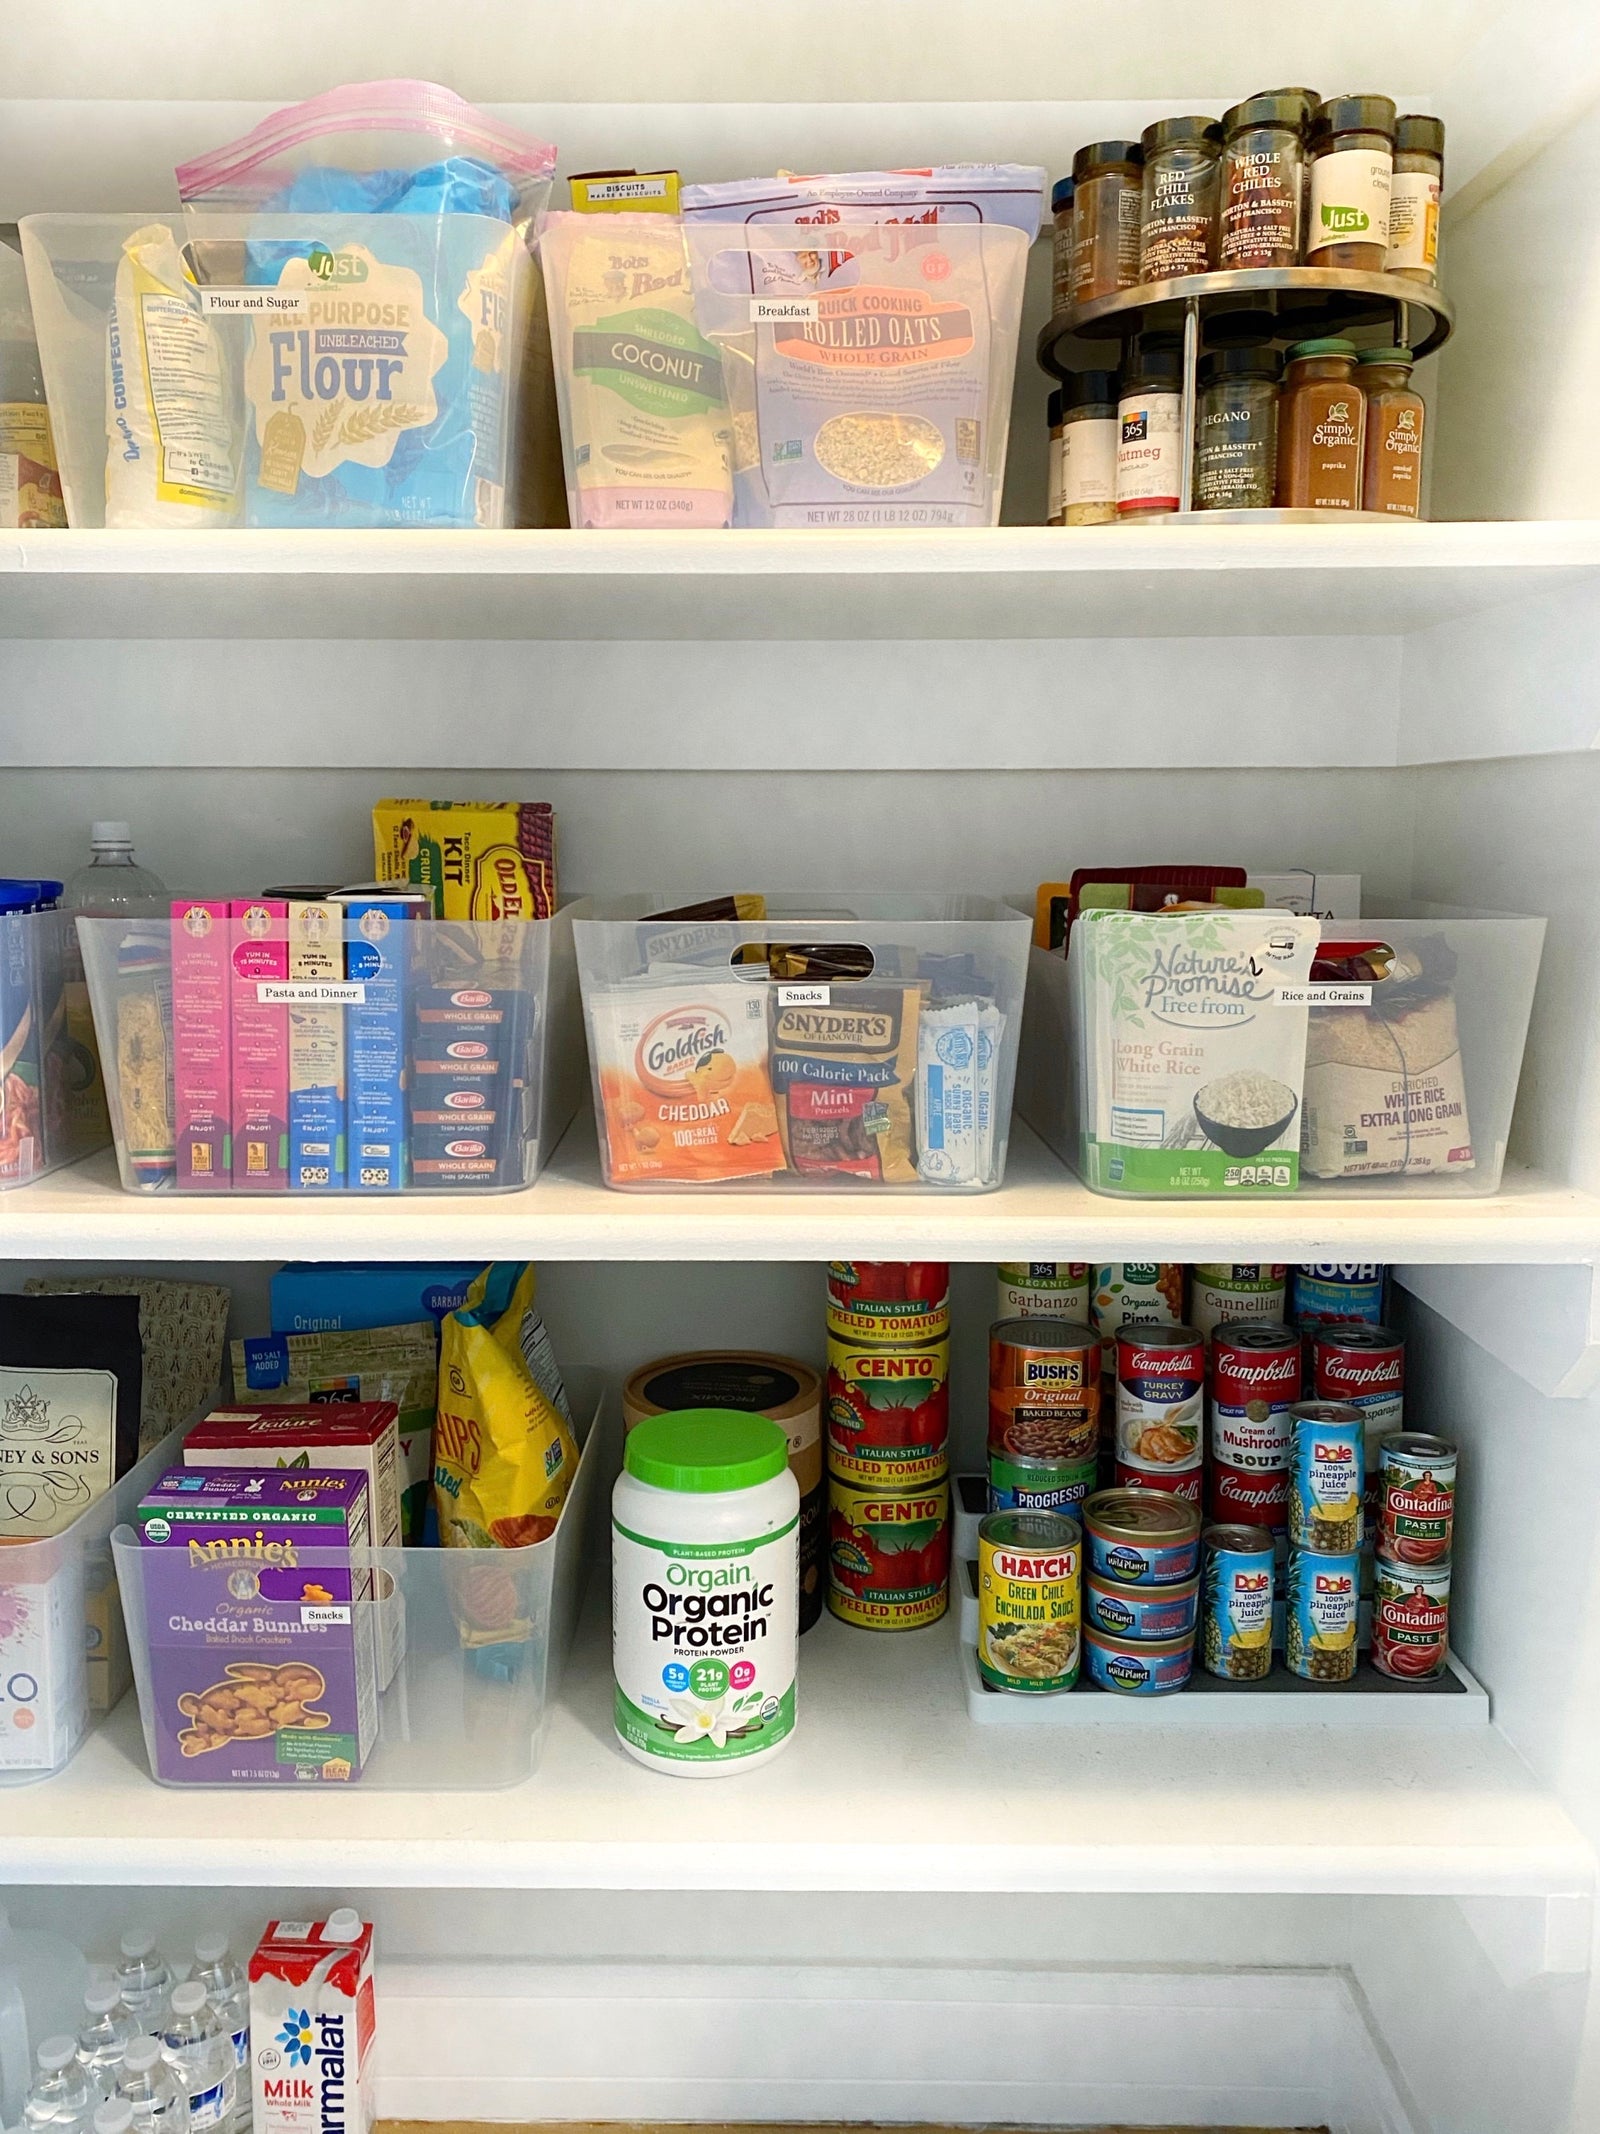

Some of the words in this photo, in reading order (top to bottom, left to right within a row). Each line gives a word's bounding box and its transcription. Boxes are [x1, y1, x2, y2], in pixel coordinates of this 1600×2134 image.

[1235, 153, 1281, 170] WHOLE
[1159, 170, 1185, 185] RED
[1243, 166, 1270, 179] RED
[606, 184, 645, 192] BISCUITS
[1155, 182, 1189, 197] CHILI
[1232, 177, 1282, 194] CHILIES
[1150, 194, 1195, 211] FLAKES
[1325, 209, 1364, 229] Just
[630, 269, 682, 300] Red
[210, 297, 241, 308] Flour
[244, 298, 263, 308] and
[266, 297, 299, 310] Sugar
[757, 305, 811, 316] Breakfast
[818, 295, 857, 315] QUICK
[862, 296, 923, 312] COOKING
[635, 324, 686, 345] SHREDDED
[803, 317, 881, 348] ROLLED
[889, 316, 942, 345] OATS
[319, 333, 399, 349] UNBLEACHED
[611, 342, 704, 382] COCONUT
[818, 350, 876, 364] WHOLE
[879, 348, 929, 363] GRAIN
[270, 330, 404, 402] Flour
[619, 374, 689, 402] UNSWEETENED
[1124, 421, 1143, 439] 365
[1317, 423, 1354, 439] Simply
[1388, 431, 1419, 444] Simply
[1313, 434, 1357, 448] Organic
[1386, 440, 1419, 454] Organic
[1322, 462, 1346, 470] paprika
[807, 511, 825, 522] NET
[827, 511, 840, 522] WT
[843, 511, 856, 522] 28
[857, 511, 870, 522] OZ
[884, 511, 896, 522] LB
[899, 511, 910, 522] 12
[912, 511, 928, 523] OZ)
[930, 511, 954, 524] 794g
[443, 837, 463, 886] KIT
[1152, 943, 1263, 977] Nature's
[265, 988, 295, 998] Pasta
[298, 988, 318, 998] and
[321, 988, 358, 998] Dinner
[785, 991, 822, 1000] Snacks
[1140, 975, 1275, 1008] Promise
[1281, 990, 1304, 1001] Rice
[1305, 990, 1326, 1001] and
[1329, 990, 1365, 1001] Grains
[1160, 996, 1197, 1013] Free
[1200, 996, 1245, 1015] from
[444, 1013, 472, 1021] WHOLE
[474, 1013, 499, 1021] GRAIN
[782, 1012, 886, 1037] SNYDER'S
[648, 1025, 727, 1072] Goldfish
[1116, 1038, 1153, 1059] Long
[1158, 1041, 1205, 1057] Grain
[440, 1064, 468, 1072] WHOLE
[470, 1064, 495, 1072] GRAIN
[778, 1060, 798, 1073] 100
[803, 1064, 853, 1081] Calorie
[857, 1068, 890, 1082] Pack
[1116, 1057, 1161, 1074] White
[1166, 1059, 1201, 1075] Rice
[1391, 1076, 1439, 1092] ENRICHED
[810, 1089, 854, 1106] Mini
[1384, 1089, 1422, 1108] WHITE
[1424, 1088, 1446, 1102] RICE
[658, 1098, 731, 1121] CHEDDAR
[1360, 1111, 1400, 1128] EXTRA
[1403, 1108, 1434, 1124] LONG
[1435, 1102, 1462, 1119] GRAIN
[438, 1114, 465, 1122] WHOLE
[467, 1114, 492, 1122] GRAIN
[438, 1162, 466, 1170] WHOLE
[467, 1162, 493, 1170] GRAIN
[1032, 1263, 1053, 1275] 365
[1235, 1267, 1257, 1279] 365
[1017, 1278, 1070, 1288] ORGANIC
[1218, 1280, 1272, 1290] ORGANIC
[1008, 1291, 1078, 1308] Garbanzo
[1121, 1295, 1160, 1309] Organic
[1205, 1292, 1280, 1310] Cannellini
[856, 1303, 892, 1313] ITALIAN
[894, 1304, 922, 1313] STYLE
[294, 1315, 342, 1332] Original
[832, 1310, 876, 1329] PEELED
[879, 1310, 947, 1330] TOMATOES
[252, 1352, 262, 1361] NO
[264, 1350, 281, 1360] SALT
[1131, 1351, 1193, 1373] Campbell's
[255, 1361, 279, 1371] ADDED
[855, 1358, 933, 1377] CENTO
[1027, 1364, 1080, 1381] BUSH'S
[1218, 1353, 1296, 1385] Campbell's
[1325, 1356, 1401, 1386] Campbell's
[1142, 1381, 1185, 1390] TURKEY
[1024, 1389, 1082, 1403] Original
[1143, 1391, 1184, 1399] GRAVY
[1022, 1409, 1053, 1417] BAKED
[1054, 1409, 1082, 1417] BEANS
[1239, 1426, 1265, 1436] Cream
[1266, 1426, 1276, 1435] of
[1223, 1430, 1290, 1450] Mushroom
[861, 1448, 898, 1458] ITALIAN
[900, 1448, 927, 1458] STYLE
[1232, 1454, 1282, 1467] SOUP
[1314, 1444, 1352, 1461] Dole
[1309, 1470, 1357, 1481] pineapple
[279, 1476, 347, 1492] Annie's
[1320, 1480, 1347, 1490] juice
[1018, 1485, 1085, 1509] PROGRESSO
[1389, 1493, 1453, 1511] Contadina
[166, 1511, 248, 1521] CERTIFIED
[253, 1512, 317, 1522] ORGANIC
[863, 1500, 938, 1522] CENTO
[1404, 1520, 1441, 1530] PASTE
[188, 1530, 299, 1569] Annie's
[1001, 1555, 1072, 1578] HATCH
[1107, 1556, 1124, 1568] Wild
[1124, 1559, 1147, 1571] Planet
[666, 1562, 751, 1594] Orgain
[1234, 1574, 1269, 1590] Dole
[1316, 1575, 1352, 1591] Dole
[869, 1590, 906, 1600] ITALIAN
[908, 1588, 932, 1600] STYLE
[1008, 1582, 1037, 1600] GREEN
[1041, 1583, 1065, 1600] CHILE
[216, 1602, 274, 1617] Organic
[642, 1582, 774, 1623] Organic
[995, 1596, 1046, 1620] ENCHILADA
[1050, 1599, 1074, 1617] SAUCE
[1309, 1600, 1355, 1611] pineapple
[308, 1610, 343, 1620] Snacks
[1097, 1606, 1113, 1620] Wild
[1112, 1612, 1134, 1625] Planet
[1240, 1608, 1264, 1619] juice
[1320, 1609, 1346, 1620] juice
[1382, 1605, 1445, 1626] Contadina
[169, 1615, 247, 1633] Cheddar
[253, 1616, 328, 1633] Bunnies
[652, 1613, 767, 1648] Protein
[1397, 1633, 1433, 1643] PASTE
[673, 1648, 709, 1657] PROTEIN
[710, 1646, 745, 1656] POWDER
[668, 1668, 685, 1681] 5g
[696, 1667, 723, 1681] 21g
[1108, 1667, 1124, 1678] Wild
[1124, 1668, 1148, 1680] Planet
[264, 2080, 314, 2099] Milk
